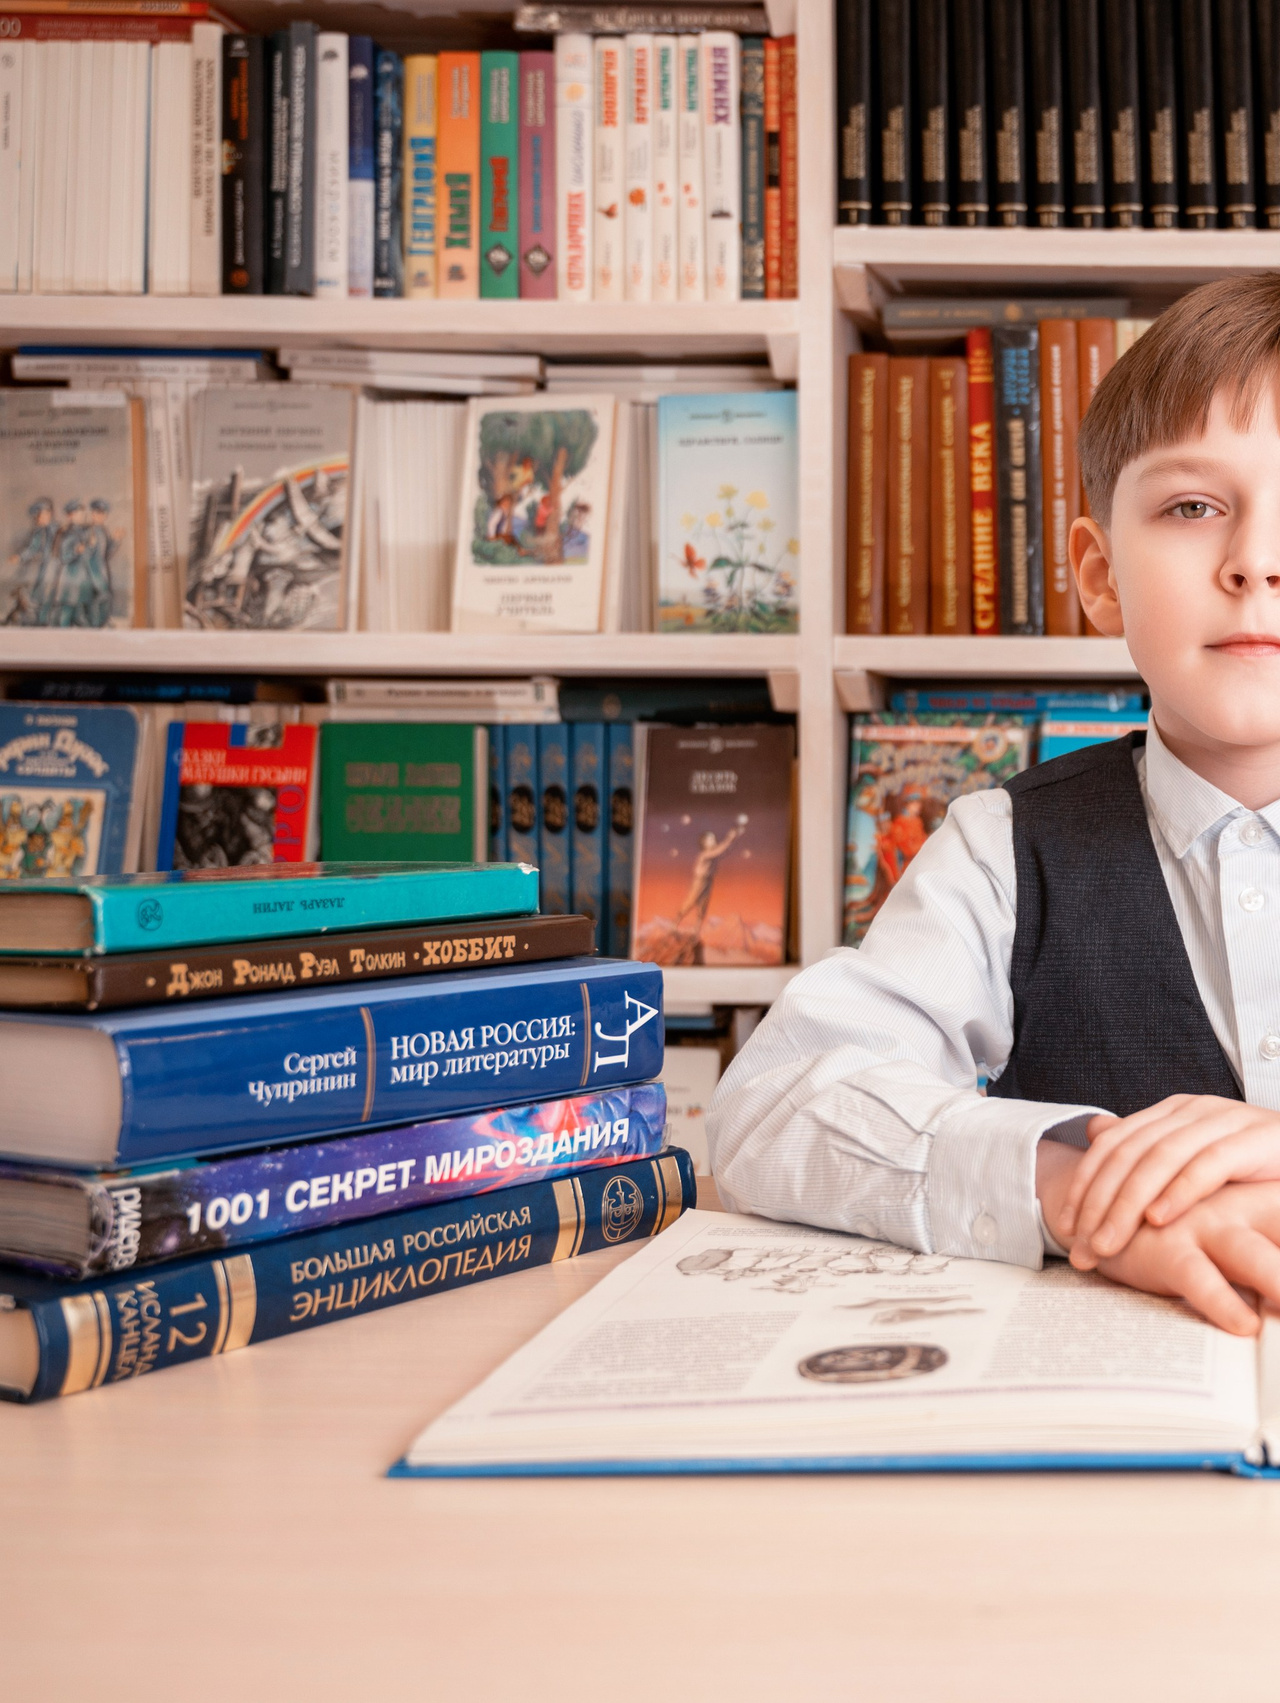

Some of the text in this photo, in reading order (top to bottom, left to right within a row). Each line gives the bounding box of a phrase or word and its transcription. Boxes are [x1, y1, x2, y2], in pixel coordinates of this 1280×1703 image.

[603, 47, 618, 127] ЗООЛОГИЯ
[634, 47, 649, 124] БОТАНИКА
[712, 47, 731, 125] ХИМИЯ
[566, 192, 586, 290] СПРАВОЧНИК
[970, 420, 995, 630] СРЕДНИЕ ВЕКА
[174, 748, 227, 766] СКАЗКИ
[181, 764, 308, 785] МАТУШКИ ГУСЫНИ
[252, 896, 345, 915] ЛАЗАРЬ ЛАГИН
[166, 935, 516, 998] Джон Роналд Руэл Толкин ХОББИТ
[283, 1045, 357, 1078] Сергей
[390, 1042, 571, 1087] мир литературы
[391, 1015, 577, 1061] НОВАЯ РОССИЯ:
[248, 1072, 357, 1108] Чупринин
[187, 1117, 631, 1235] 1001 СЕКРЕТ МИРОЗДАНИЯ
[290, 1205, 532, 1285] БОЛЬШАЯ РОССИЙСКАЯ
[289, 1233, 533, 1322] ЭНЦИКЛОПЕДИЯ
[167, 1292, 208, 1353] 12
